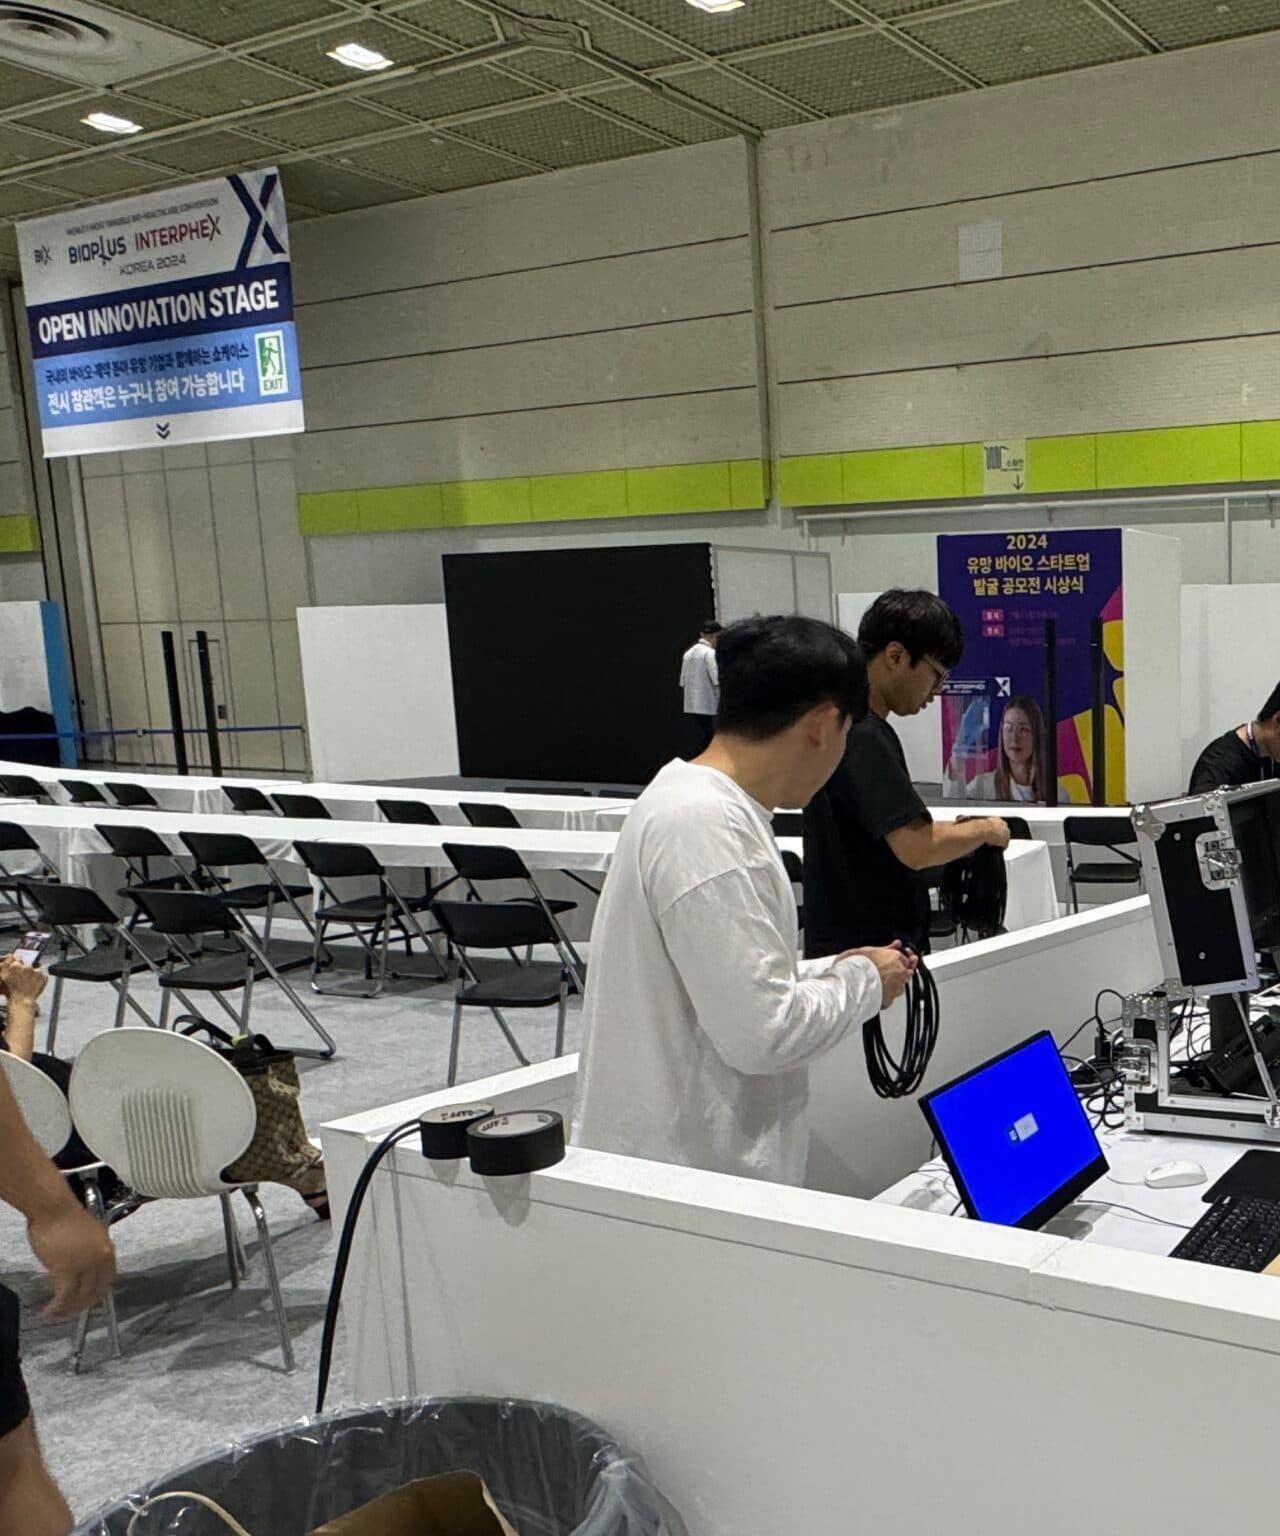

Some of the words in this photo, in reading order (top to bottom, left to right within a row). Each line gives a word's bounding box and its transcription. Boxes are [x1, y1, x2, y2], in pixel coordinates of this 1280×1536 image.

[135, 213, 222, 251] INTERPHEX
[120, 259, 154, 276] KOREA
[156, 253, 187, 271] 2024
[38, 312, 90, 345] OPEN
[90, 291, 206, 337] INNOVATION
[209, 279, 280, 318] STAGE
[213, 343, 250, 362] 쇼케이스
[48, 392, 71, 416] 전시
[71, 386, 117, 413] 참관객은
[118, 380, 153, 407] 누구나
[154, 376, 181, 403] 참여
[182, 368, 246, 397] 가능합니다
[263, 378, 284, 391] EXIT
[1006, 534, 1049, 550] 2024
[967, 556, 993, 574] 유망
[995, 555, 1035, 573] 바이오
[1037, 553, 1091, 571] 스타트업
[973, 578, 999, 596] 발굴
[1002, 577, 1041, 595] 공모전
[1044, 577, 1084, 594] 시상식
